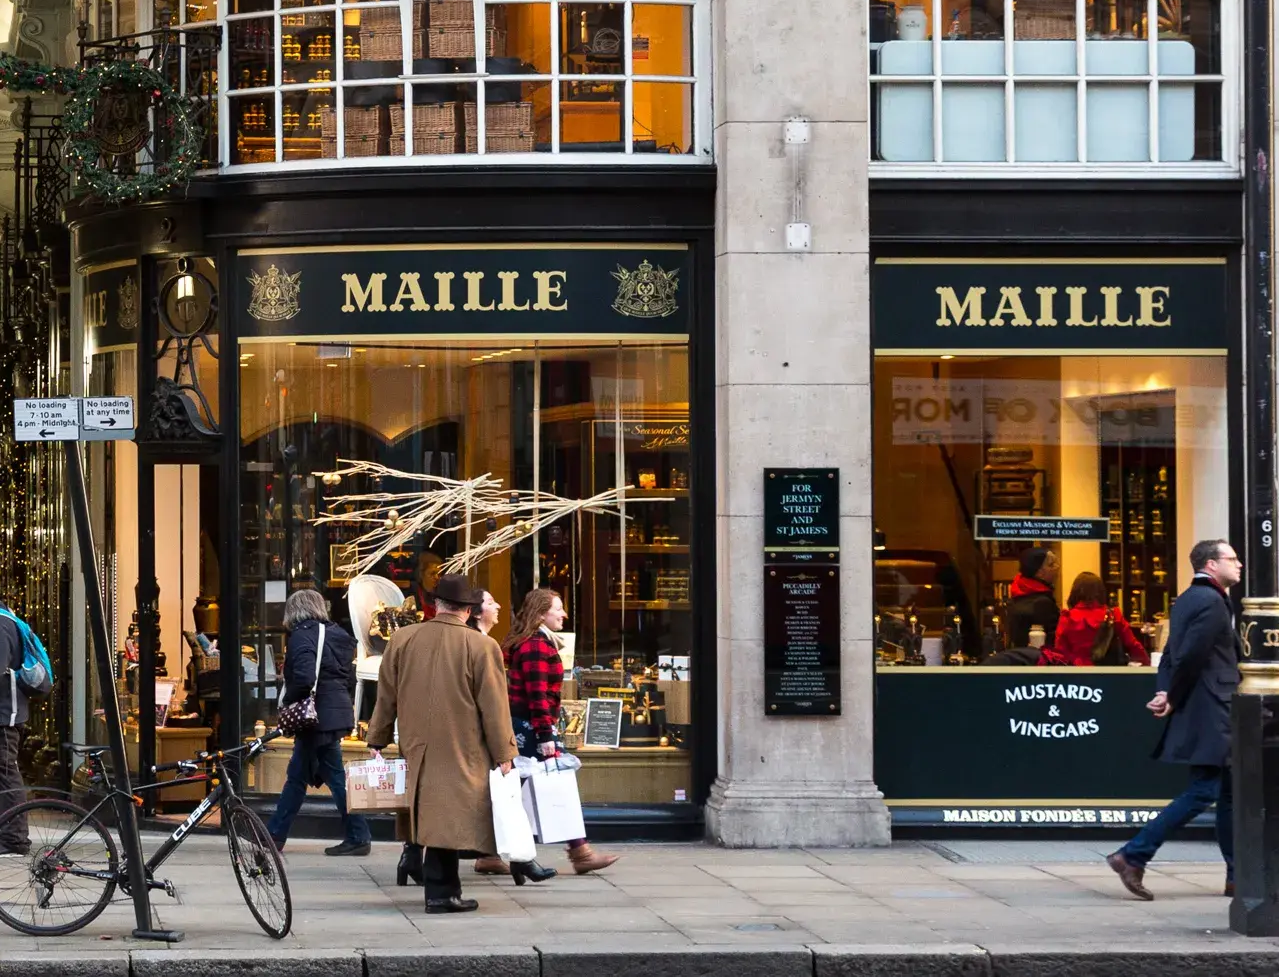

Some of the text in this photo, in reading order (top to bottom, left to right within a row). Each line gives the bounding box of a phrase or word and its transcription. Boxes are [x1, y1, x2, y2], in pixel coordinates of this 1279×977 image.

[340, 270, 569, 313] MAILLE
[935, 286, 1171, 327] MAILLE
[39, 401, 66, 410] loading
[86, 400, 129, 408] No loading
[96, 409, 110, 417] any
[24, 420, 36, 428] pm
[41, 419, 76, 427] Midnight
[631, 425, 677, 435] Seasonal
[791, 484, 812, 493] FOR
[780, 494, 822, 505] JERMYN
[782, 505, 821, 514] STREET
[790, 516, 814, 524] AND
[1056, 521, 1063, 529] &
[776, 527, 790, 535] ST
[1005, 683, 1103, 704] MUSTARDS
[1048, 704, 1061, 717] &
[1009, 718, 1100, 738] VINEGARS
[172, 797, 212, 841] CUBE
[942, 809, 1017, 823] MAISON
[1020, 808, 1097, 823] FONDÉE
[1099, 809, 1126, 823] EN
